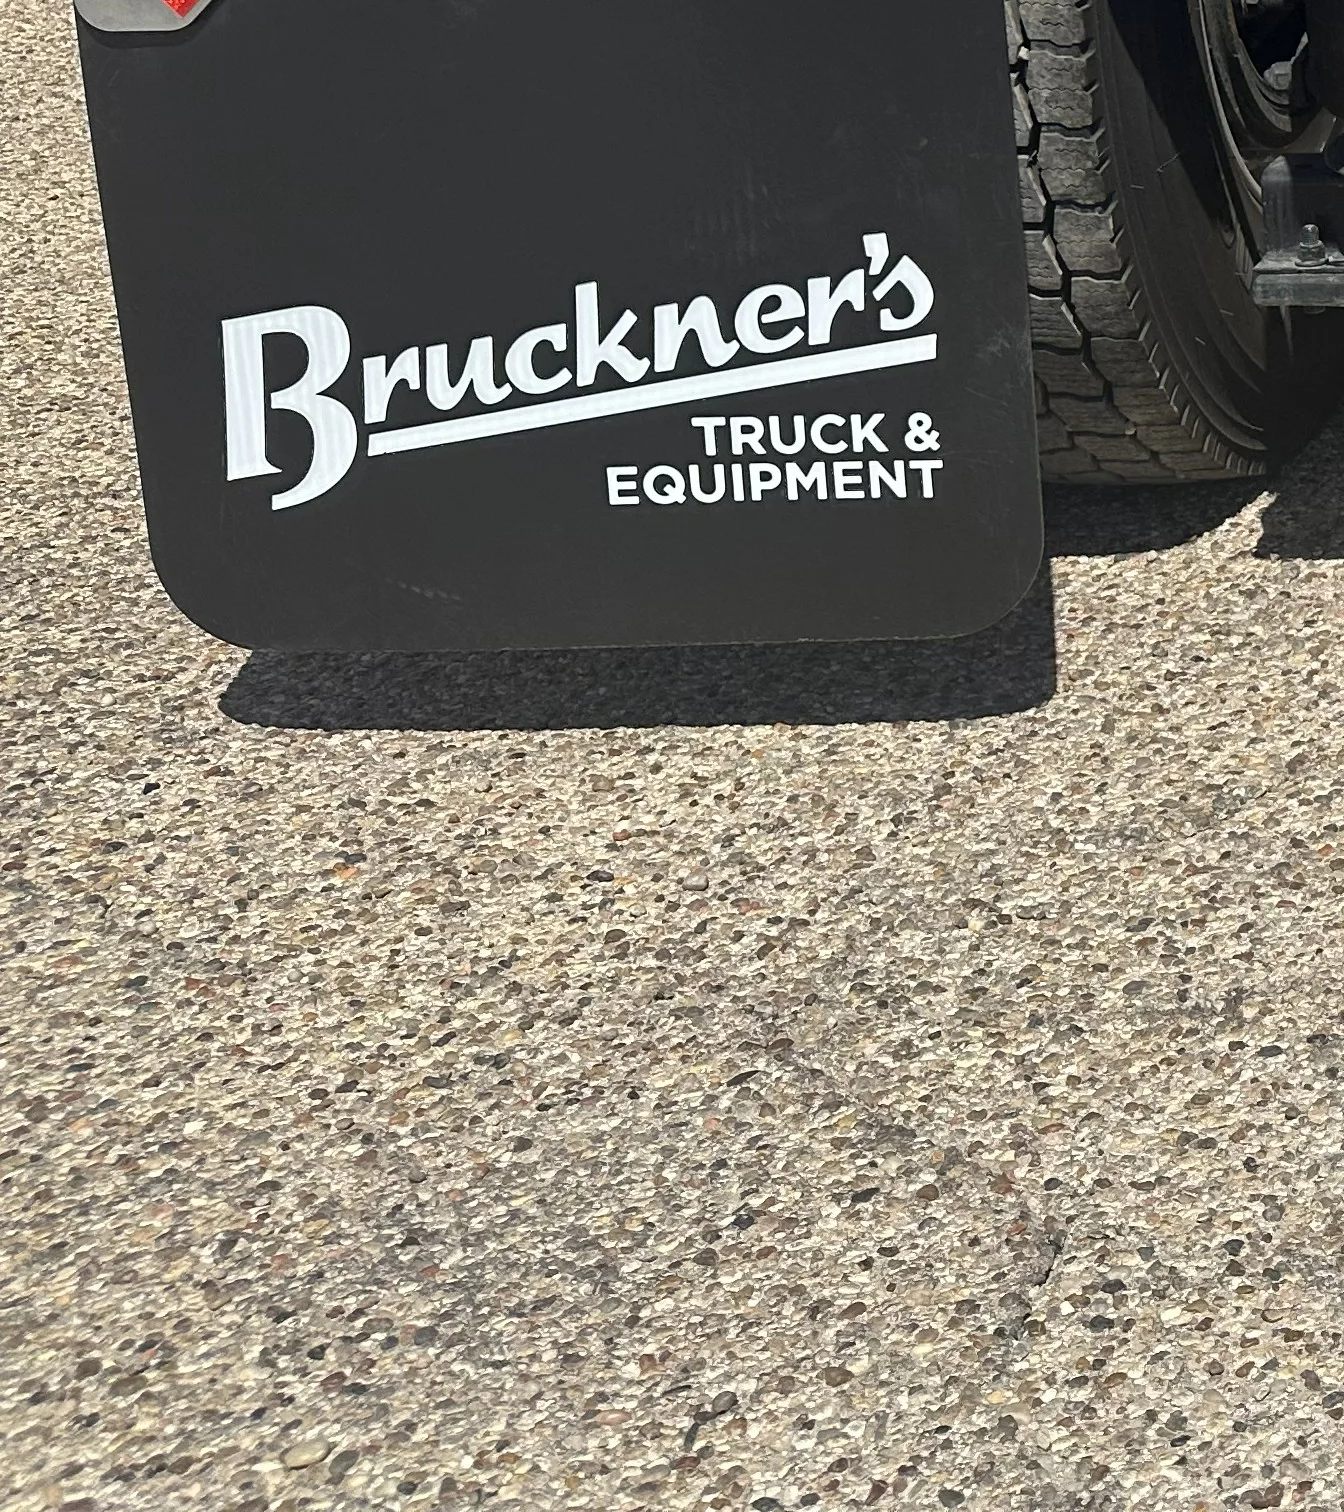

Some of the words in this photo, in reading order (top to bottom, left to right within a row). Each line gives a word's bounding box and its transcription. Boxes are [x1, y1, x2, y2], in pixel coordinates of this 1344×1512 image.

[221, 232, 935, 511] Bruckner's
[690, 411, 890, 458] TRUCK
[904, 411, 941, 453] &
[606, 459, 944, 506] EQUIPMENT
